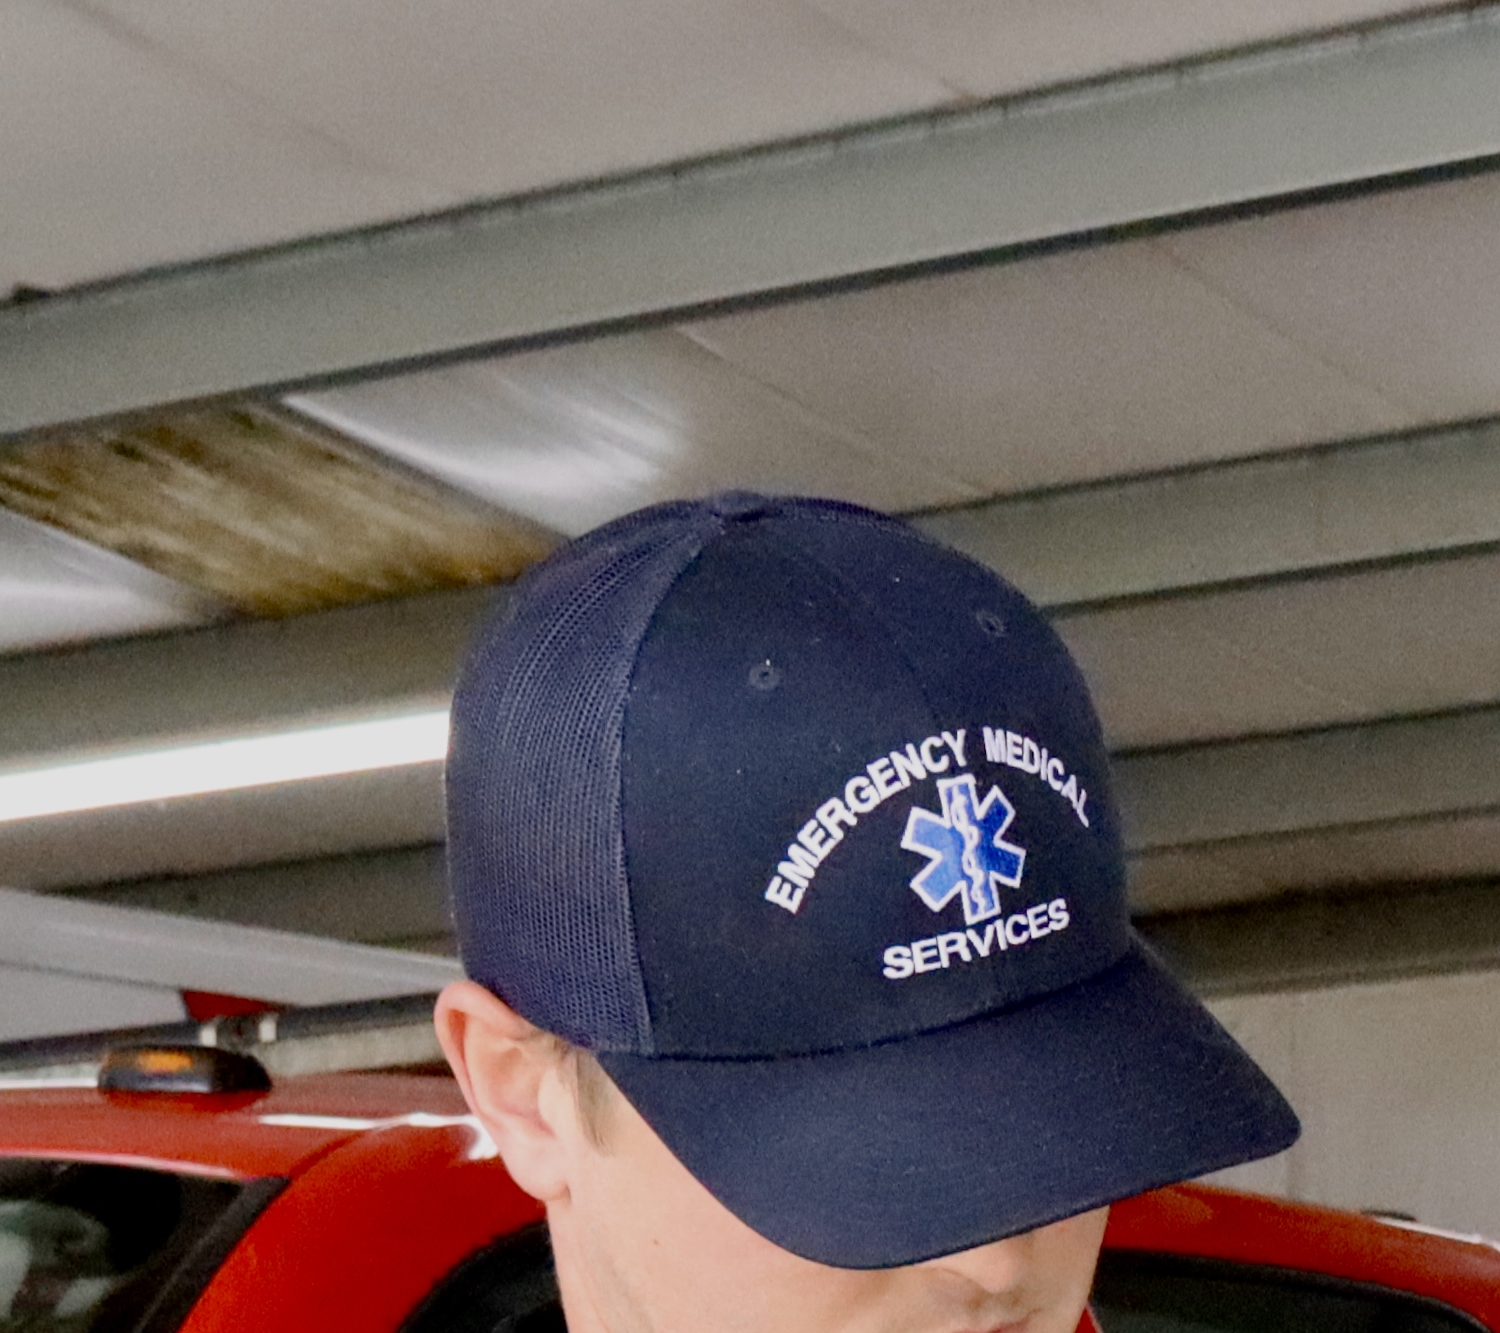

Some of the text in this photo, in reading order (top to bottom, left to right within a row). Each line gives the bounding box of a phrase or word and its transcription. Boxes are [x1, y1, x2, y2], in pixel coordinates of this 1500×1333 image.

[765, 726, 1089, 914] EMERGENCY MEDICAL
[883, 898, 1069, 979] SERVICES
